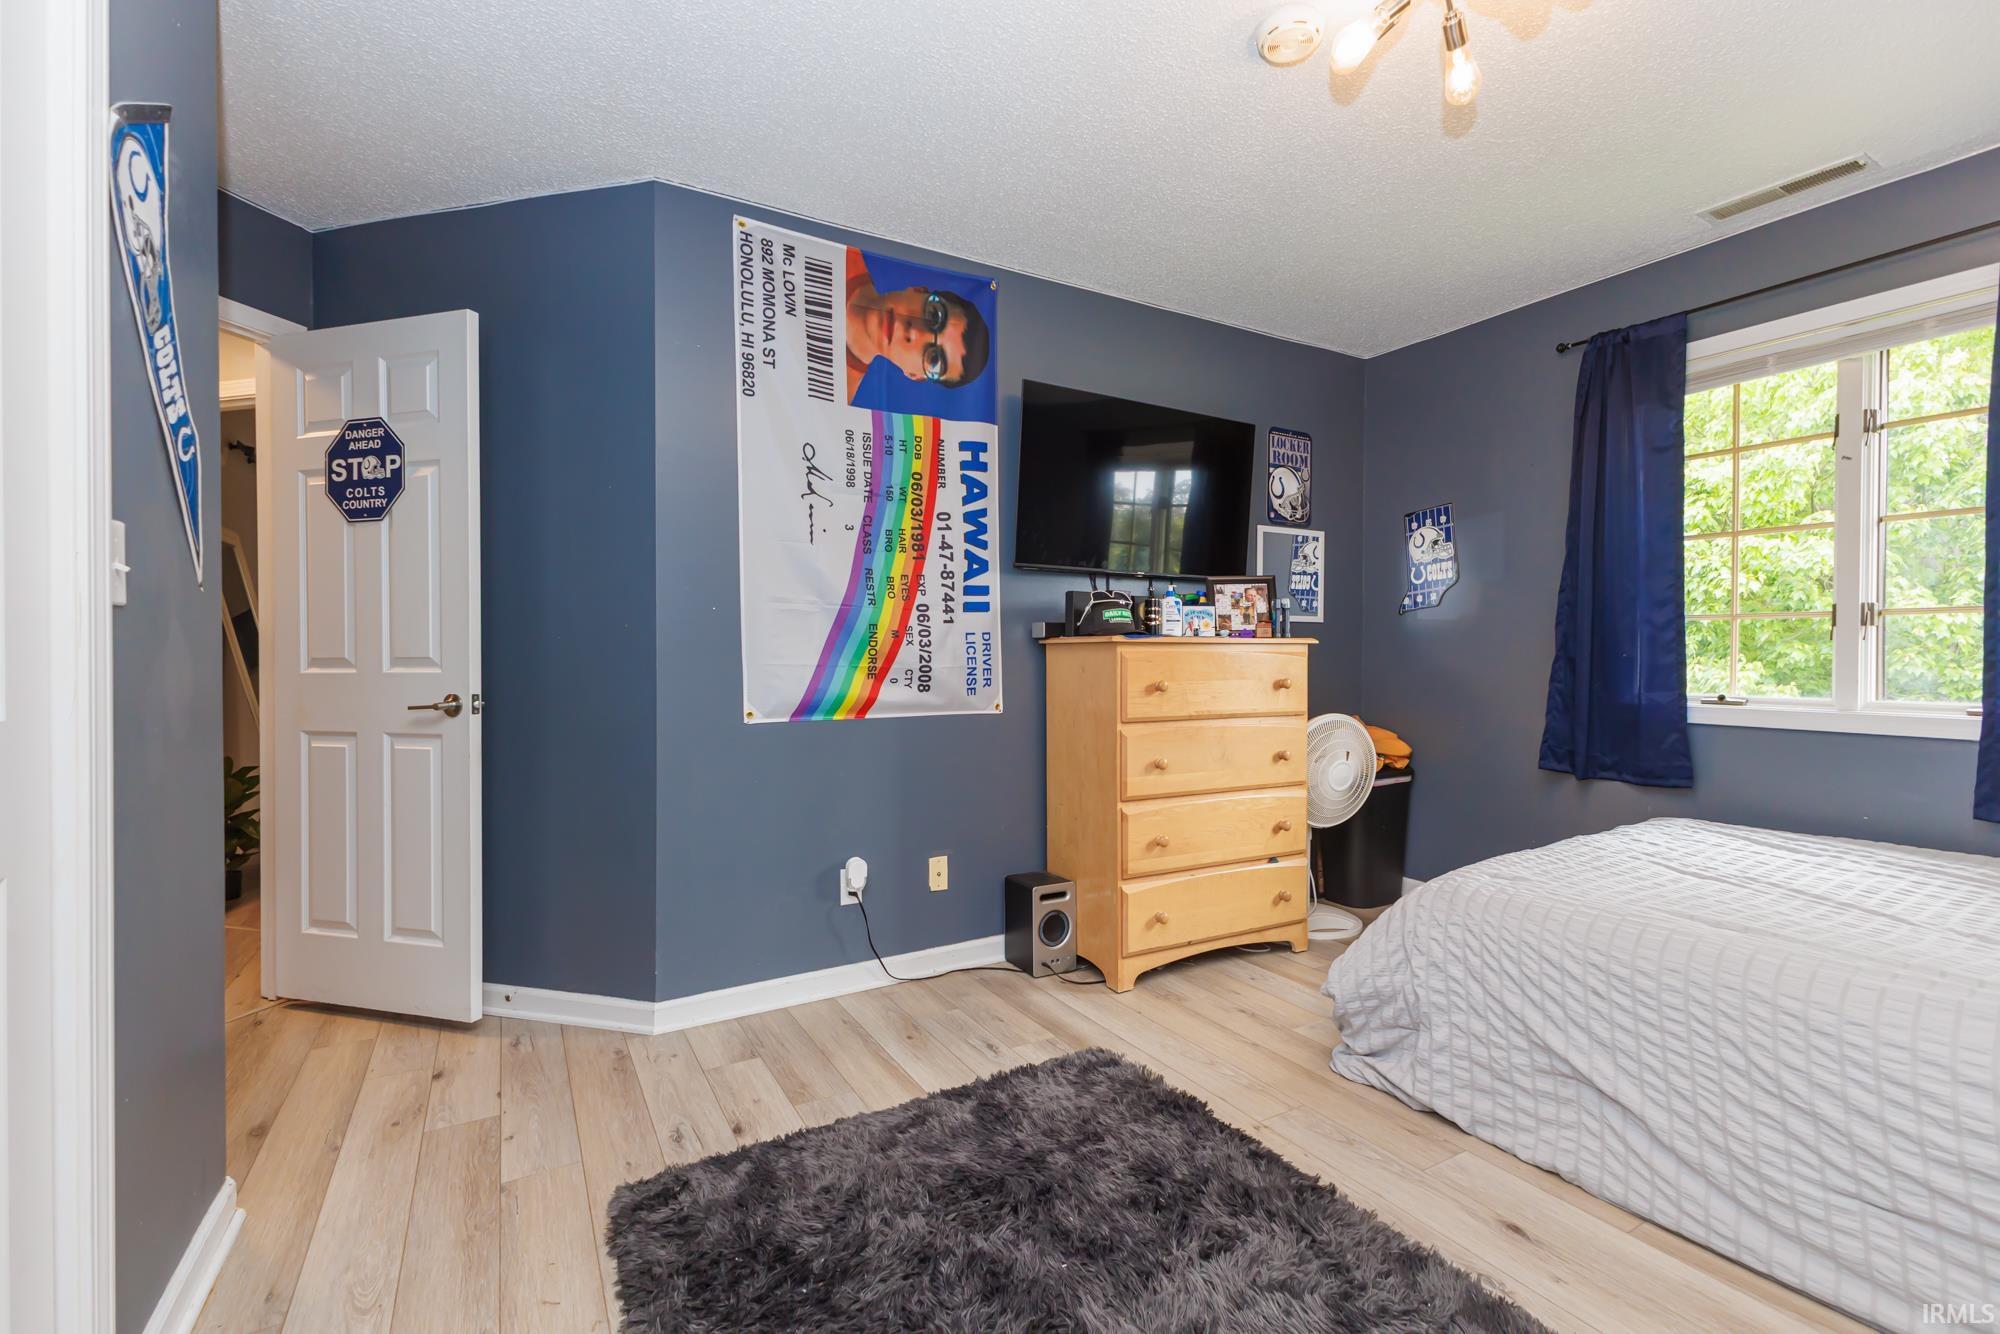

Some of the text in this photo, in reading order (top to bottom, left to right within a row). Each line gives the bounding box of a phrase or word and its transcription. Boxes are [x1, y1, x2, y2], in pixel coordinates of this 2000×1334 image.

[783, 243, 797, 318] Mc LOVIN
[739, 230, 756, 397] HONOLULU, HI 96820
[760, 238, 776, 369] 892 MOMONA ST
[153, 324, 187, 425] COLTS
[345, 427, 385, 440] DANGER
[348, 439, 382, 451] AHEAD
[884, 434, 893, 456] 5-10
[1271, 435, 1309, 455] LOCKER
[331, 454, 402, 482] STP
[844, 429, 856, 488] 06/18/1998
[1272, 449, 1309, 469] ROOM
[342, 498, 388, 510] COUNTRY
[346, 486, 385, 498] COLTS
[885, 484, 894, 502] 150
[885, 529, 893, 553] BRO
[936, 439, 955, 624] NUMBER 01-47-87441
[958, 440, 991, 613] HAWAII
[862, 432, 878, 680] ISSUE DATE CLASS RESTR ENDORSE
[898, 439, 914, 689] HT WT HAIR EYES SEX CTY
[910, 435, 932, 693] DOB 06/03/1981 EXP 06/03/2008
[1426, 560, 1453, 582] COLTS
[886, 576, 895, 599] BRO
[965, 632, 977, 696] LICENSE
[981, 632, 992, 688] DRIVER
